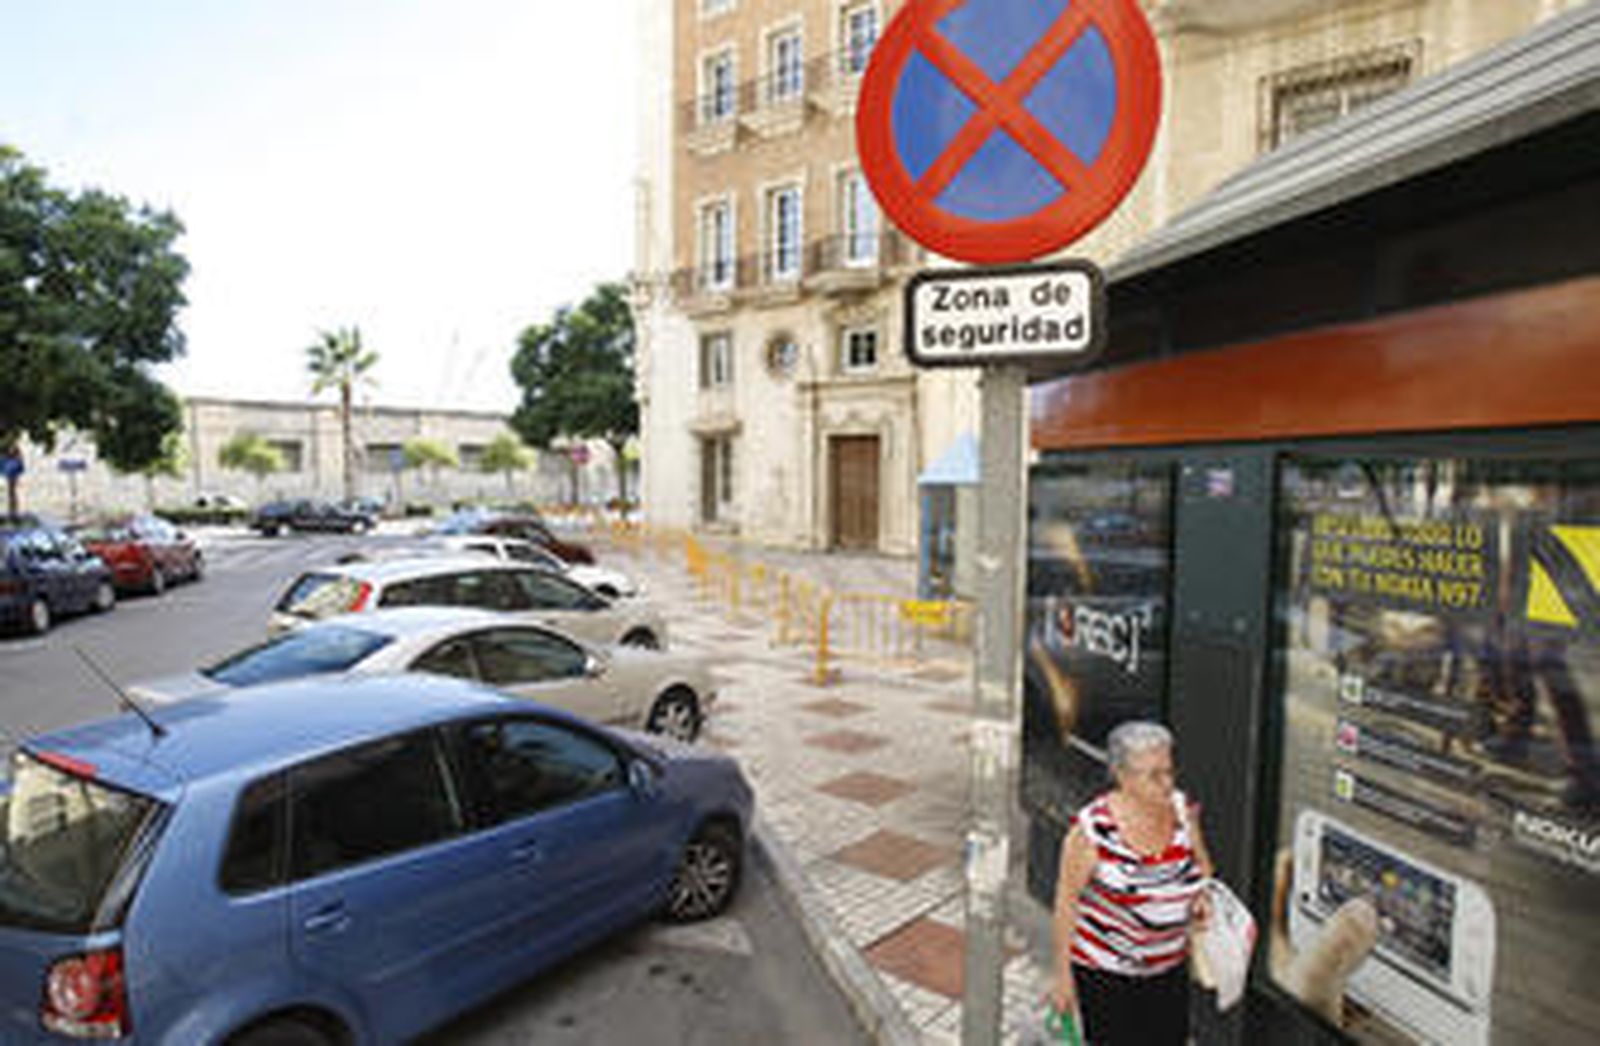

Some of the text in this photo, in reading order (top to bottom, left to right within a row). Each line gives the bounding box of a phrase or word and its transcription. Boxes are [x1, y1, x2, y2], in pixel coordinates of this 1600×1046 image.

[931, 280, 1071, 311] Zona de
[921, 313, 1084, 349] seguridad
